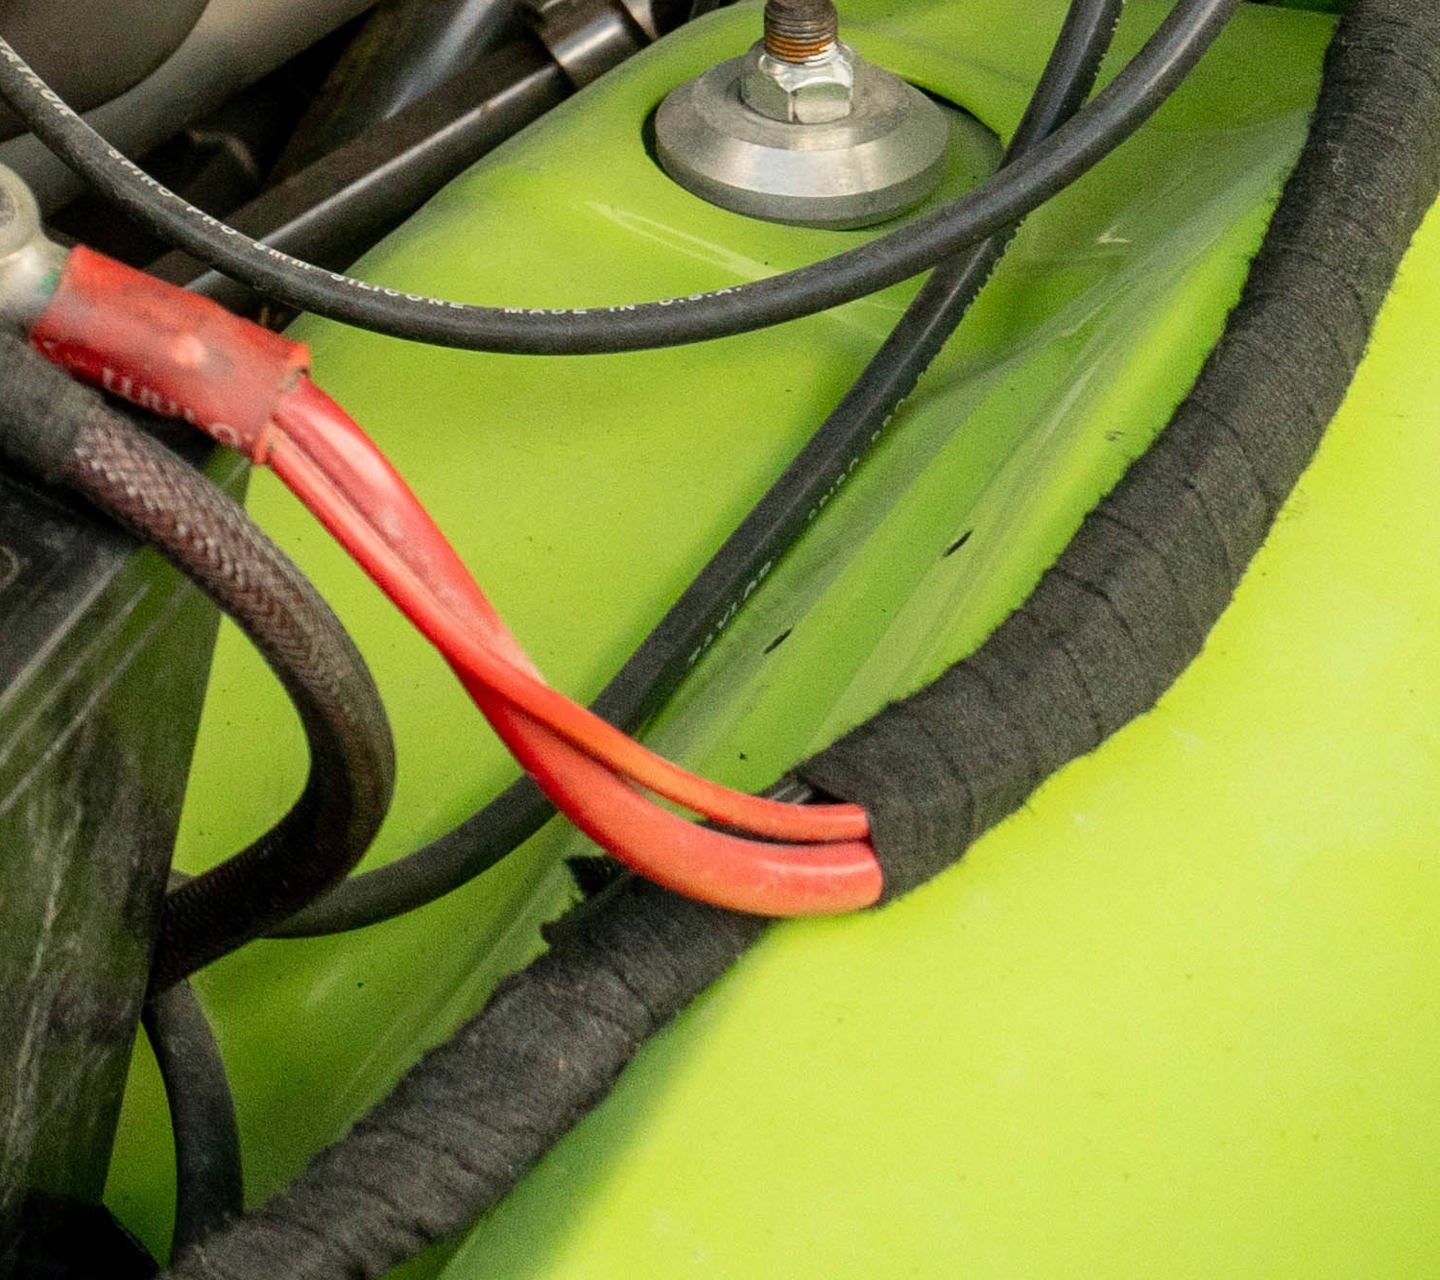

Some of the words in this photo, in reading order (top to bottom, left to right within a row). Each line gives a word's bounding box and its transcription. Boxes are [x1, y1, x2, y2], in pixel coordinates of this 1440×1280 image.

[106, 145, 173, 201] SPIRO
[186, 203, 236, 238] PRO
[329, 273, 464, 309] SILICONE
[504, 304, 587, 318] MADE
[608, 302, 636, 314] IN
